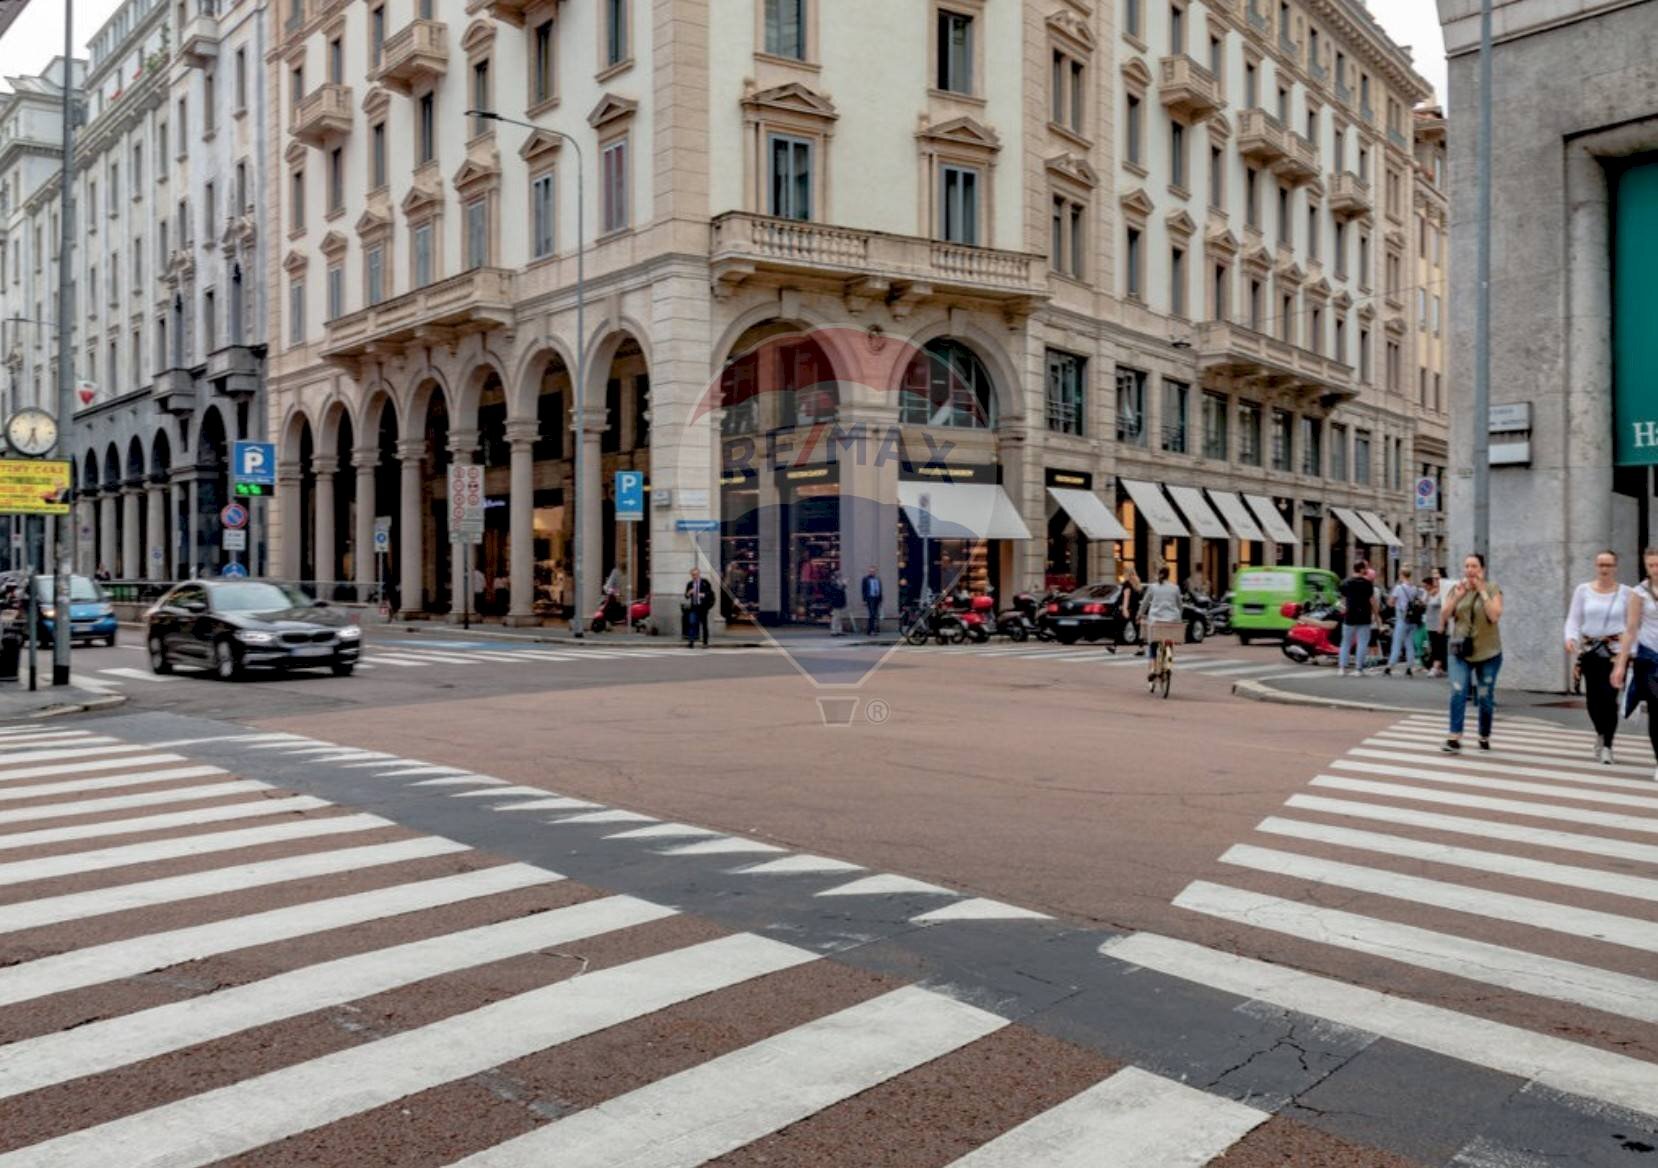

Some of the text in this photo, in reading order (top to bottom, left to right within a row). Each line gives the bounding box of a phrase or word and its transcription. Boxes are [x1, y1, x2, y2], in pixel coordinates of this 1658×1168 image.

[1631, 420, 1658, 447] H
[244, 451, 264, 474] P
[622, 474, 637, 494] P
